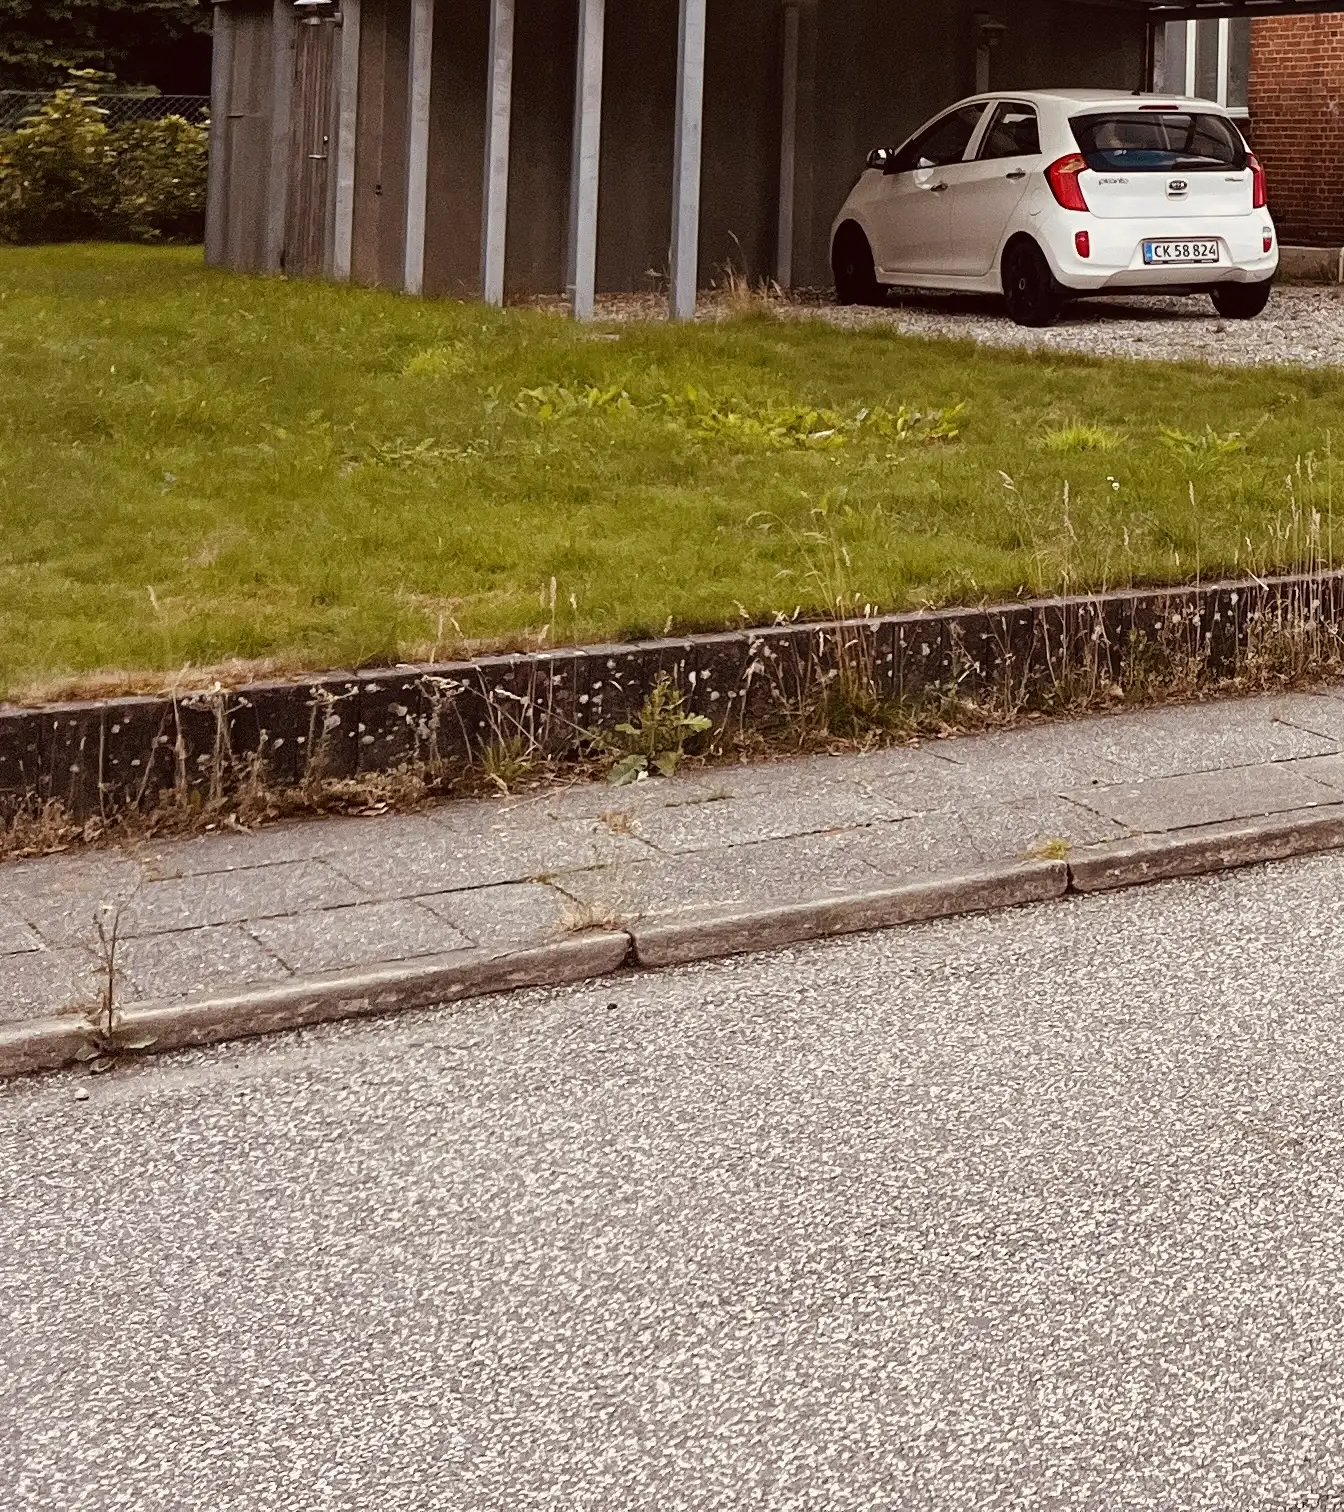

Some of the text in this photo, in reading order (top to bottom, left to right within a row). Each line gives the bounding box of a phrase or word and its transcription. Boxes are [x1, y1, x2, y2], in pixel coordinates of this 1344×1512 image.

[1154, 243, 1216, 258] CK 58 824
